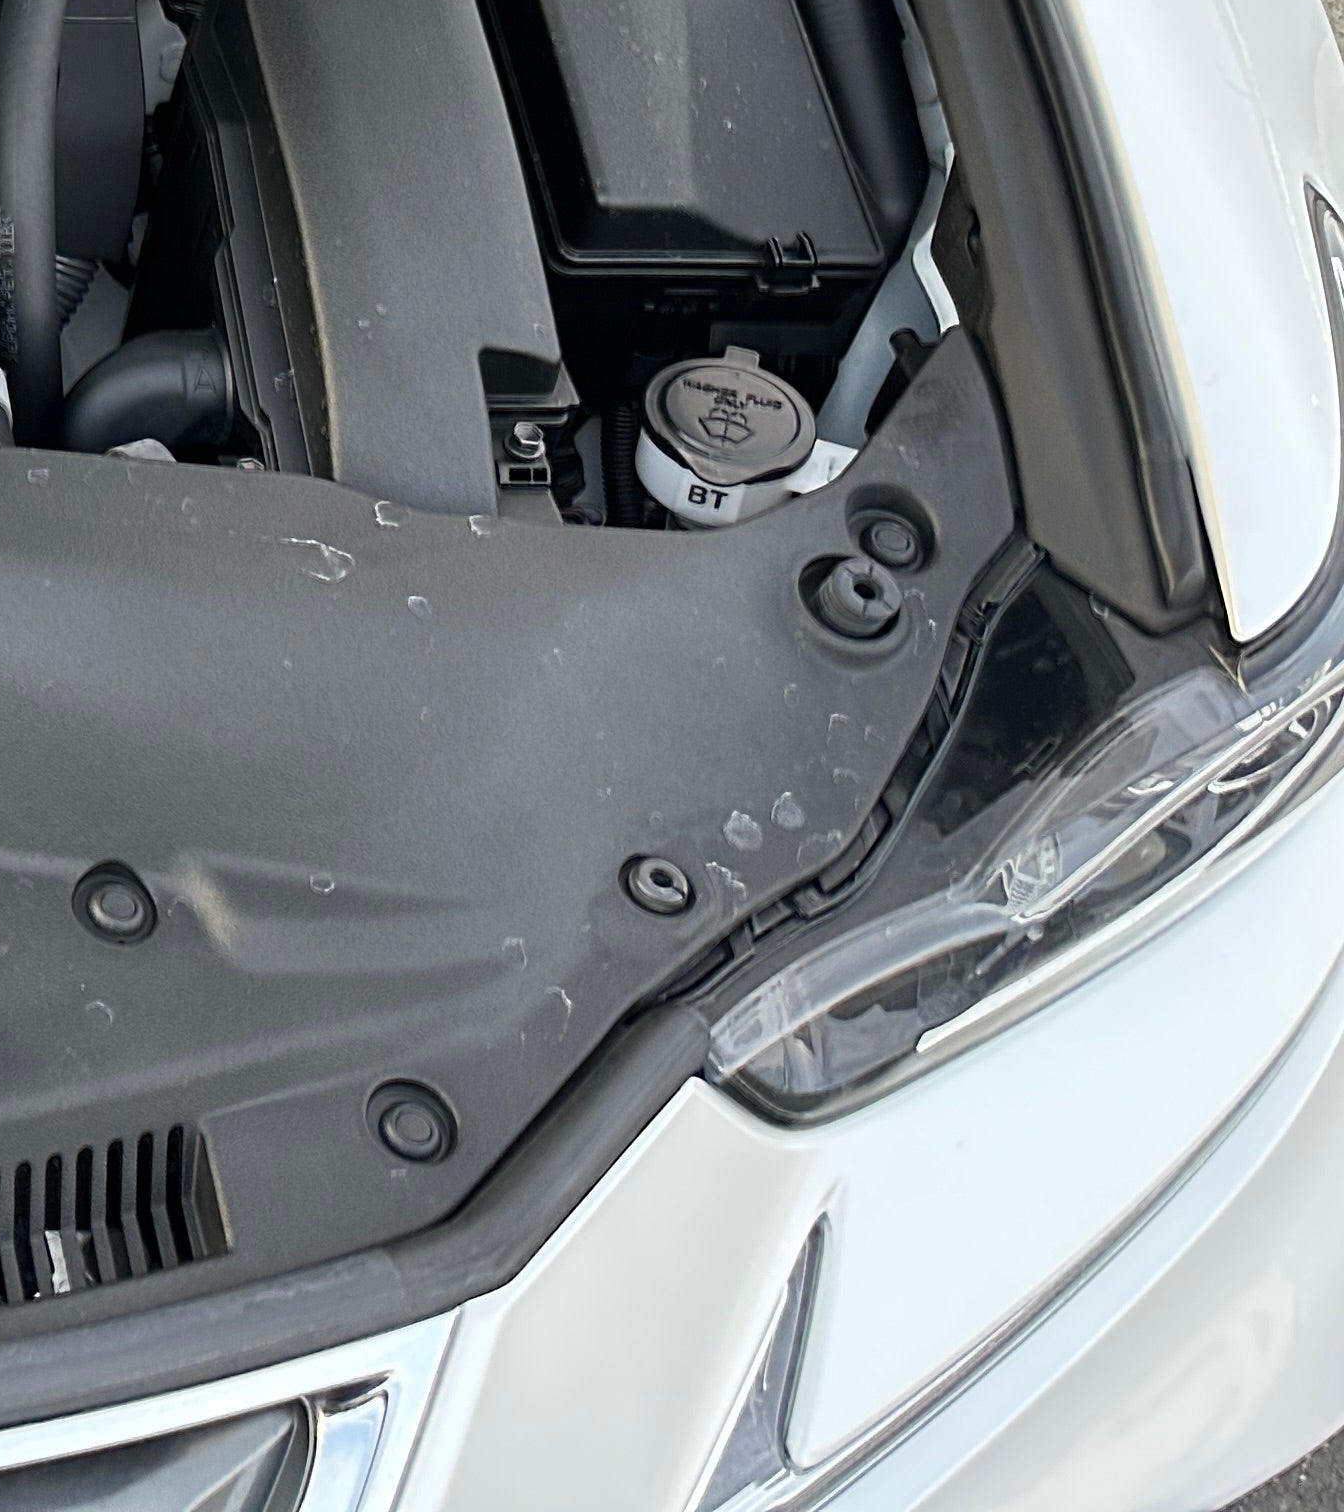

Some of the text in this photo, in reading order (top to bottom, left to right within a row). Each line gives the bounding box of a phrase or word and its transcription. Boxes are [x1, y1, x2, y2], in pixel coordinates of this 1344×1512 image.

[682, 379, 782, 409] WASHER FLUID
[687, 484, 729, 510] BT
